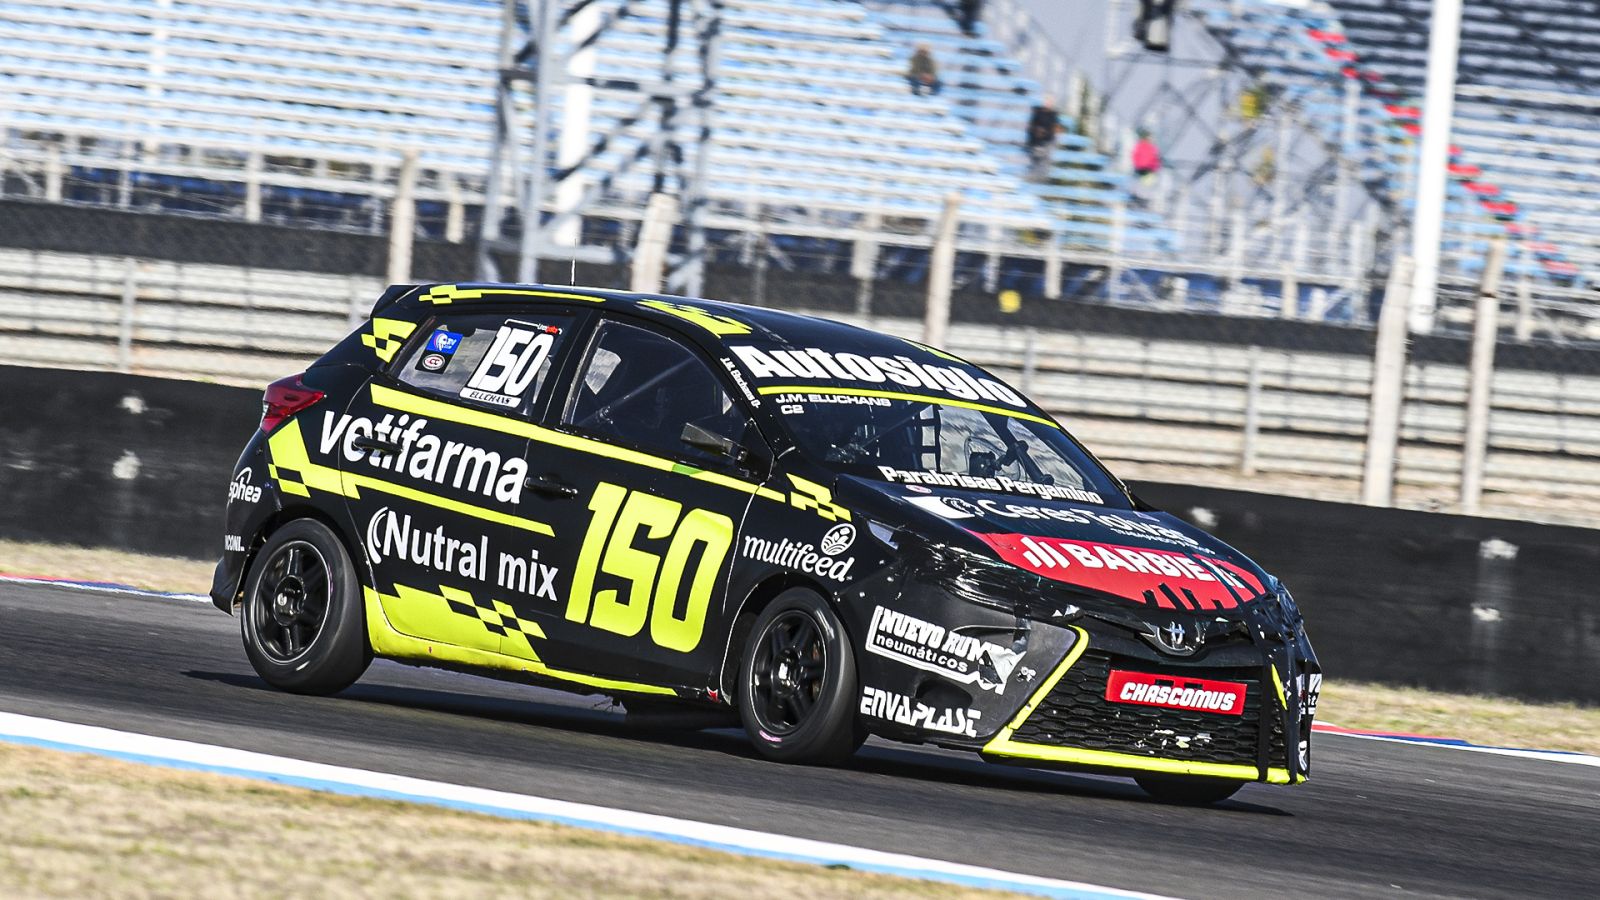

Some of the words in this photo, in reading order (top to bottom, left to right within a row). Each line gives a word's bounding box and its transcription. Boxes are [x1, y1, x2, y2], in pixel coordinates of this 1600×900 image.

[467, 325, 554, 396] 150
[729, 345, 1028, 408] Autosiglo
[775, 393, 808, 404] J.M.
[808, 394, 892, 407] ELUCHANS
[781, 404, 804, 415] C2
[319, 410, 529, 504] vetifarma
[877, 465, 1001, 491] Parabrisas
[1001, 476, 1105, 505] Pergamino
[382, 510, 488, 581] Nutral
[497, 549, 559, 602] mix
[565, 481, 734, 654] 150
[743, 535, 854, 582] multifeed
[878, 608, 946, 649] NUEVO
[876, 635, 968, 673] neumáticos
[860, 686, 982, 738] ENVAPLAST
[1119, 681, 1237, 711] CHASCOMUS
